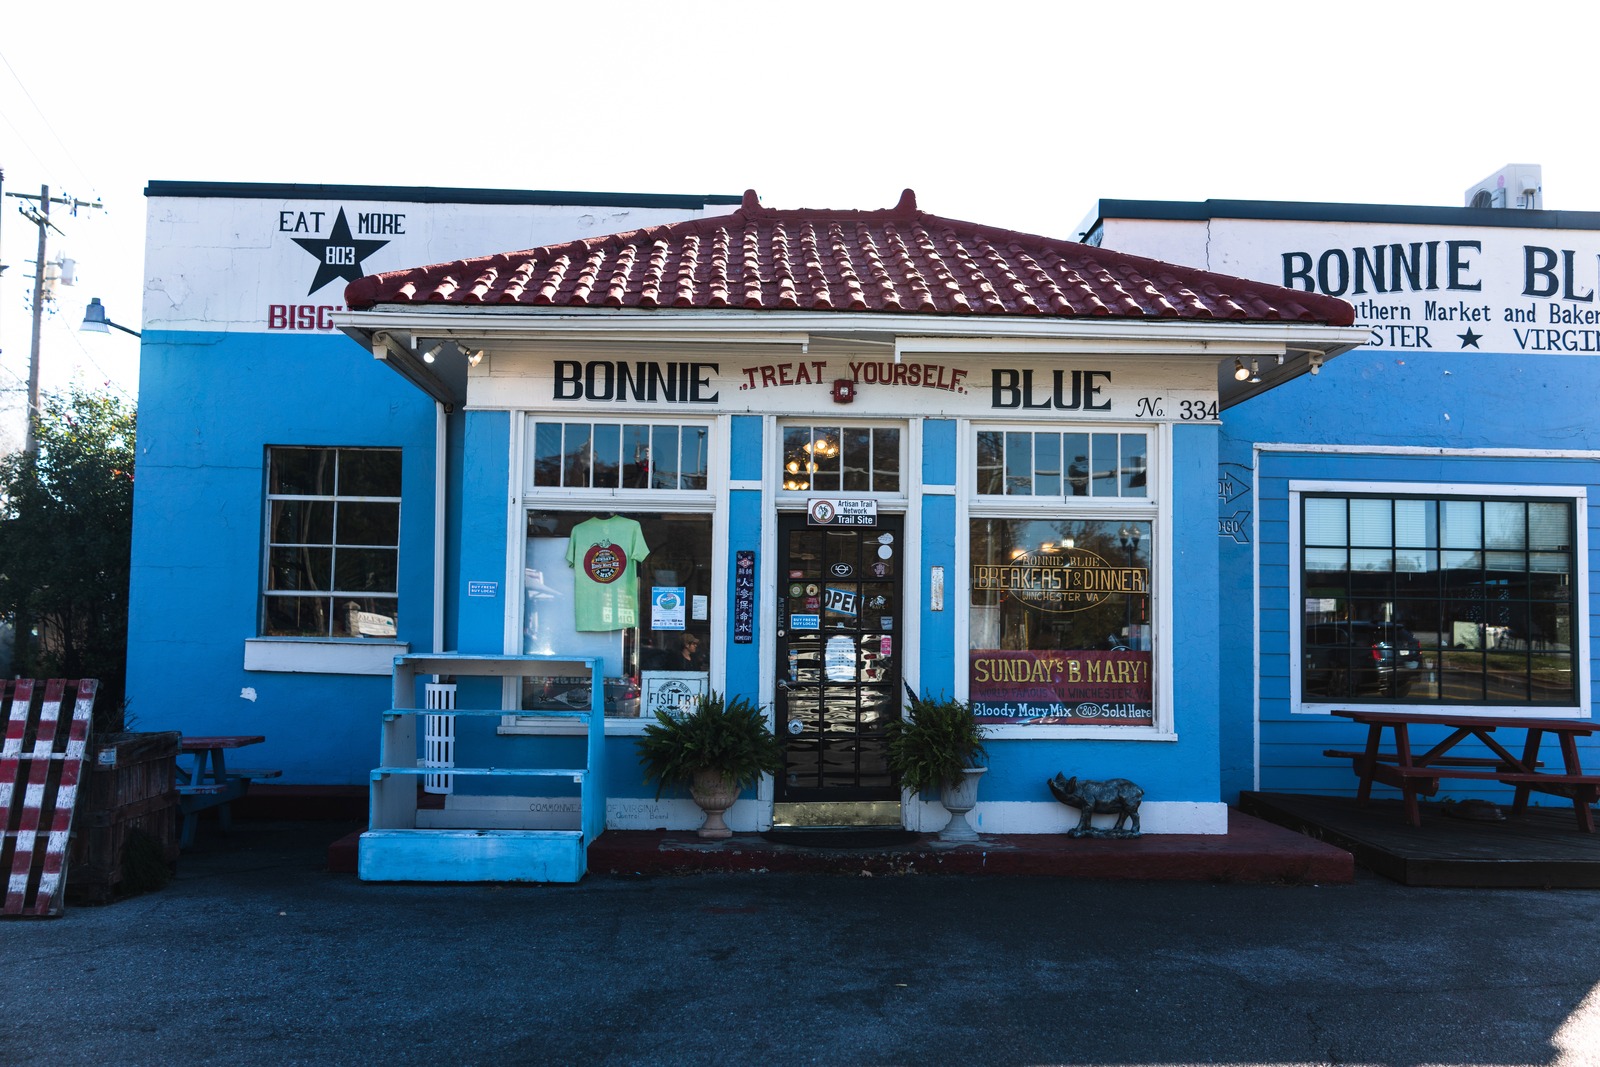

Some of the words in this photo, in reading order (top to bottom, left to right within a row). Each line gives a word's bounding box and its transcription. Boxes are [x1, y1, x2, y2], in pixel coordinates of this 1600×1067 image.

[279, 211, 325, 232] EAT
[358, 213, 406, 234] MORE
[325, 246, 356, 265] 803
[1281, 240, 1482, 297] BONNIE
[1521, 245, 1600, 302] BL
[268, 304, 345, 330] BISC
[1354, 299, 1411, 320] thern
[1424, 300, 1491, 322] Market
[1504, 302, 1536, 323] and
[553, 360, 719, 404] BONNIE
[991, 368, 1112, 411] BLUE
[1135, 397, 1166, 418] No.
[1179, 400, 1219, 421] 334
[838, 500, 859, 508] Artisan
[860, 500, 873, 508] Trail
[843, 507, 868, 515] Network
[837, 515, 855, 524] Trail
[857, 516, 873, 525] Site
[1022, 555, 1064, 567] BONNIE
[1069, 555, 1101, 568] BLUE
[979, 567, 1072, 590] BREAKFAST
[1073, 571, 1082, 587] &
[1083, 569, 1143, 591] DINNER
[1022, 591, 1080, 602] WINCHESTER
[1086, 592, 1099, 602] VA
[650, 693, 674, 705] FISH
[678, 694, 698, 706] FRY
[979, 688, 1008, 698] WORLD
[1011, 688, 1048, 698] FAMOUS
[973, 702, 1015, 718] Bloody
[1018, 703, 1047, 718] Mary
[1050, 703, 1072, 717] Mix
[1101, 703, 1127, 718] Sold
[1128, 704, 1151, 718] Here
[622, 804, 660, 813] VIRGINIA
